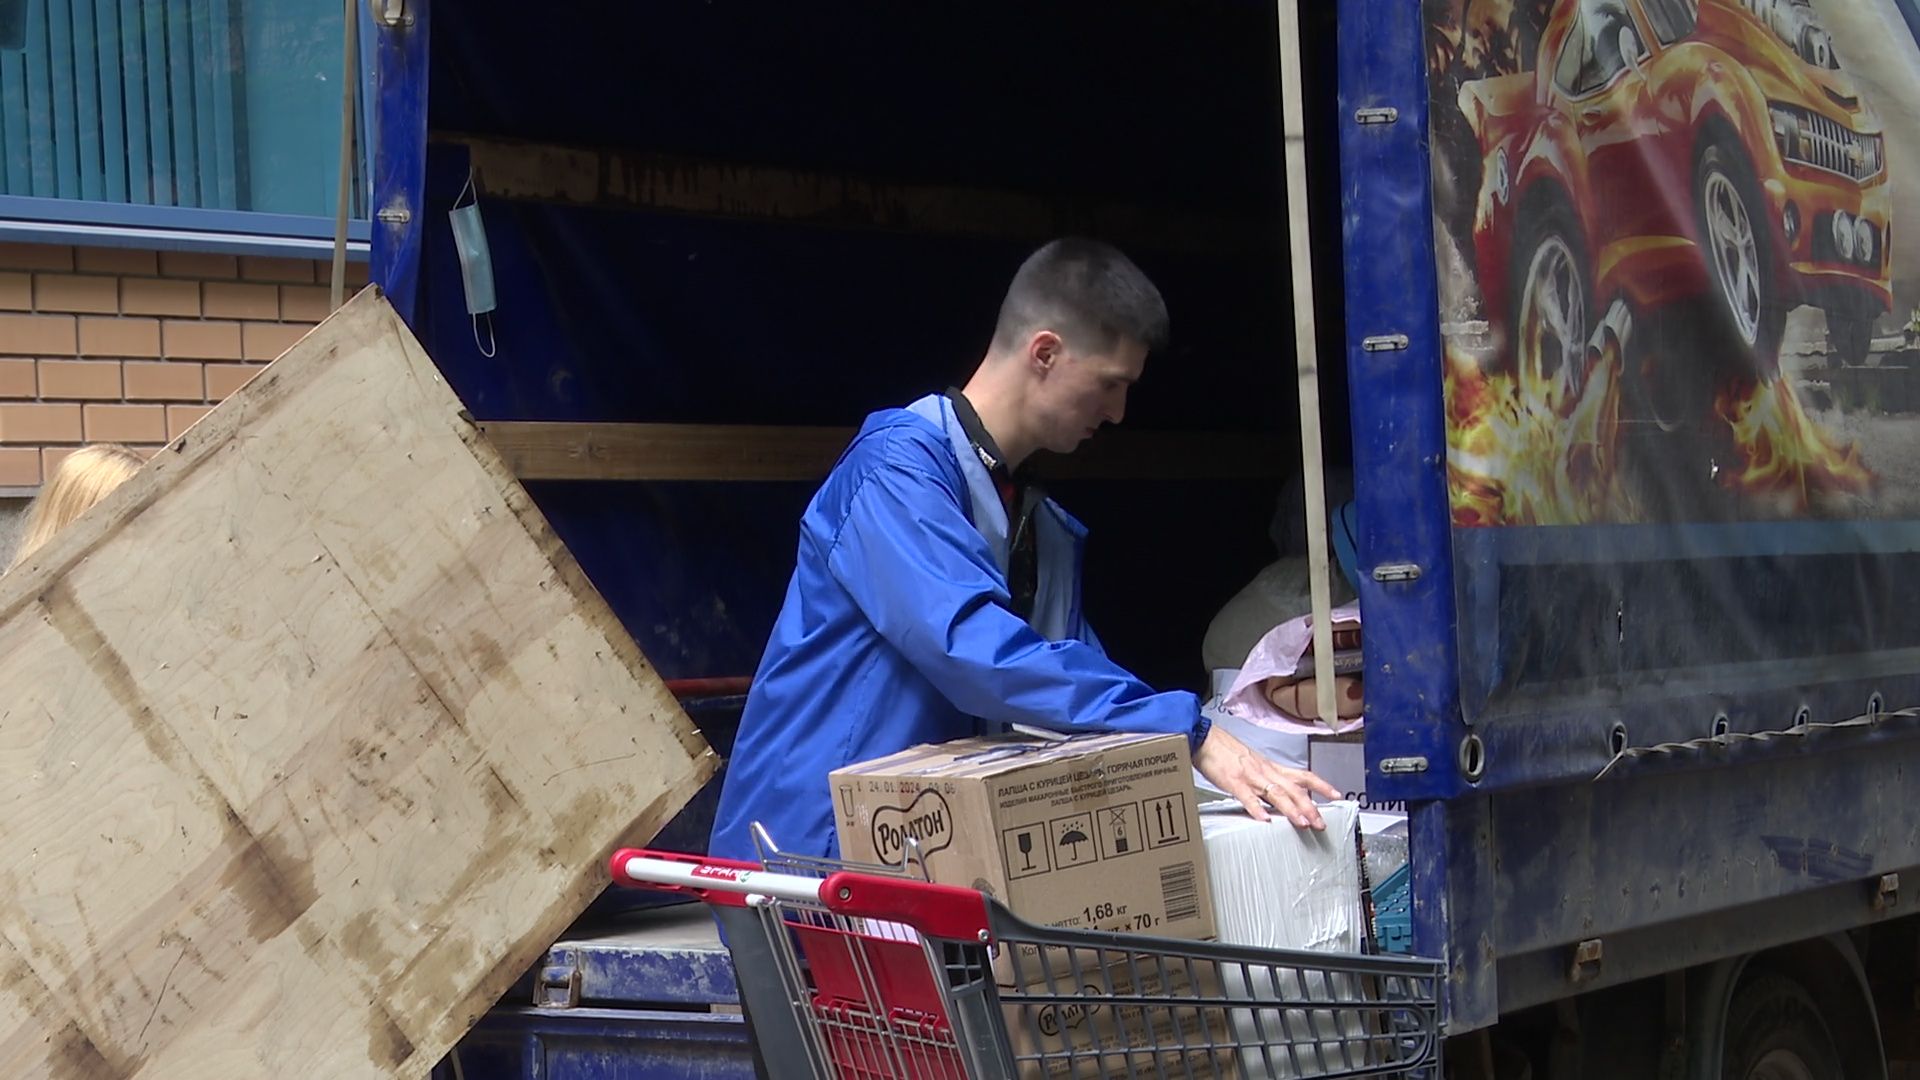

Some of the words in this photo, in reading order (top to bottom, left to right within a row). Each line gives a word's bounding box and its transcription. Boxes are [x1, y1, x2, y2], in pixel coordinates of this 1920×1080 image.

[998, 784, 1028, 797] ЛАПША
[1107, 759, 1143, 774] ГОРЯЧАЯ
[1083, 902, 1113, 924] 1,68
[1116, 905, 1127, 916] кг
[1133, 913, 1151, 931] 70
